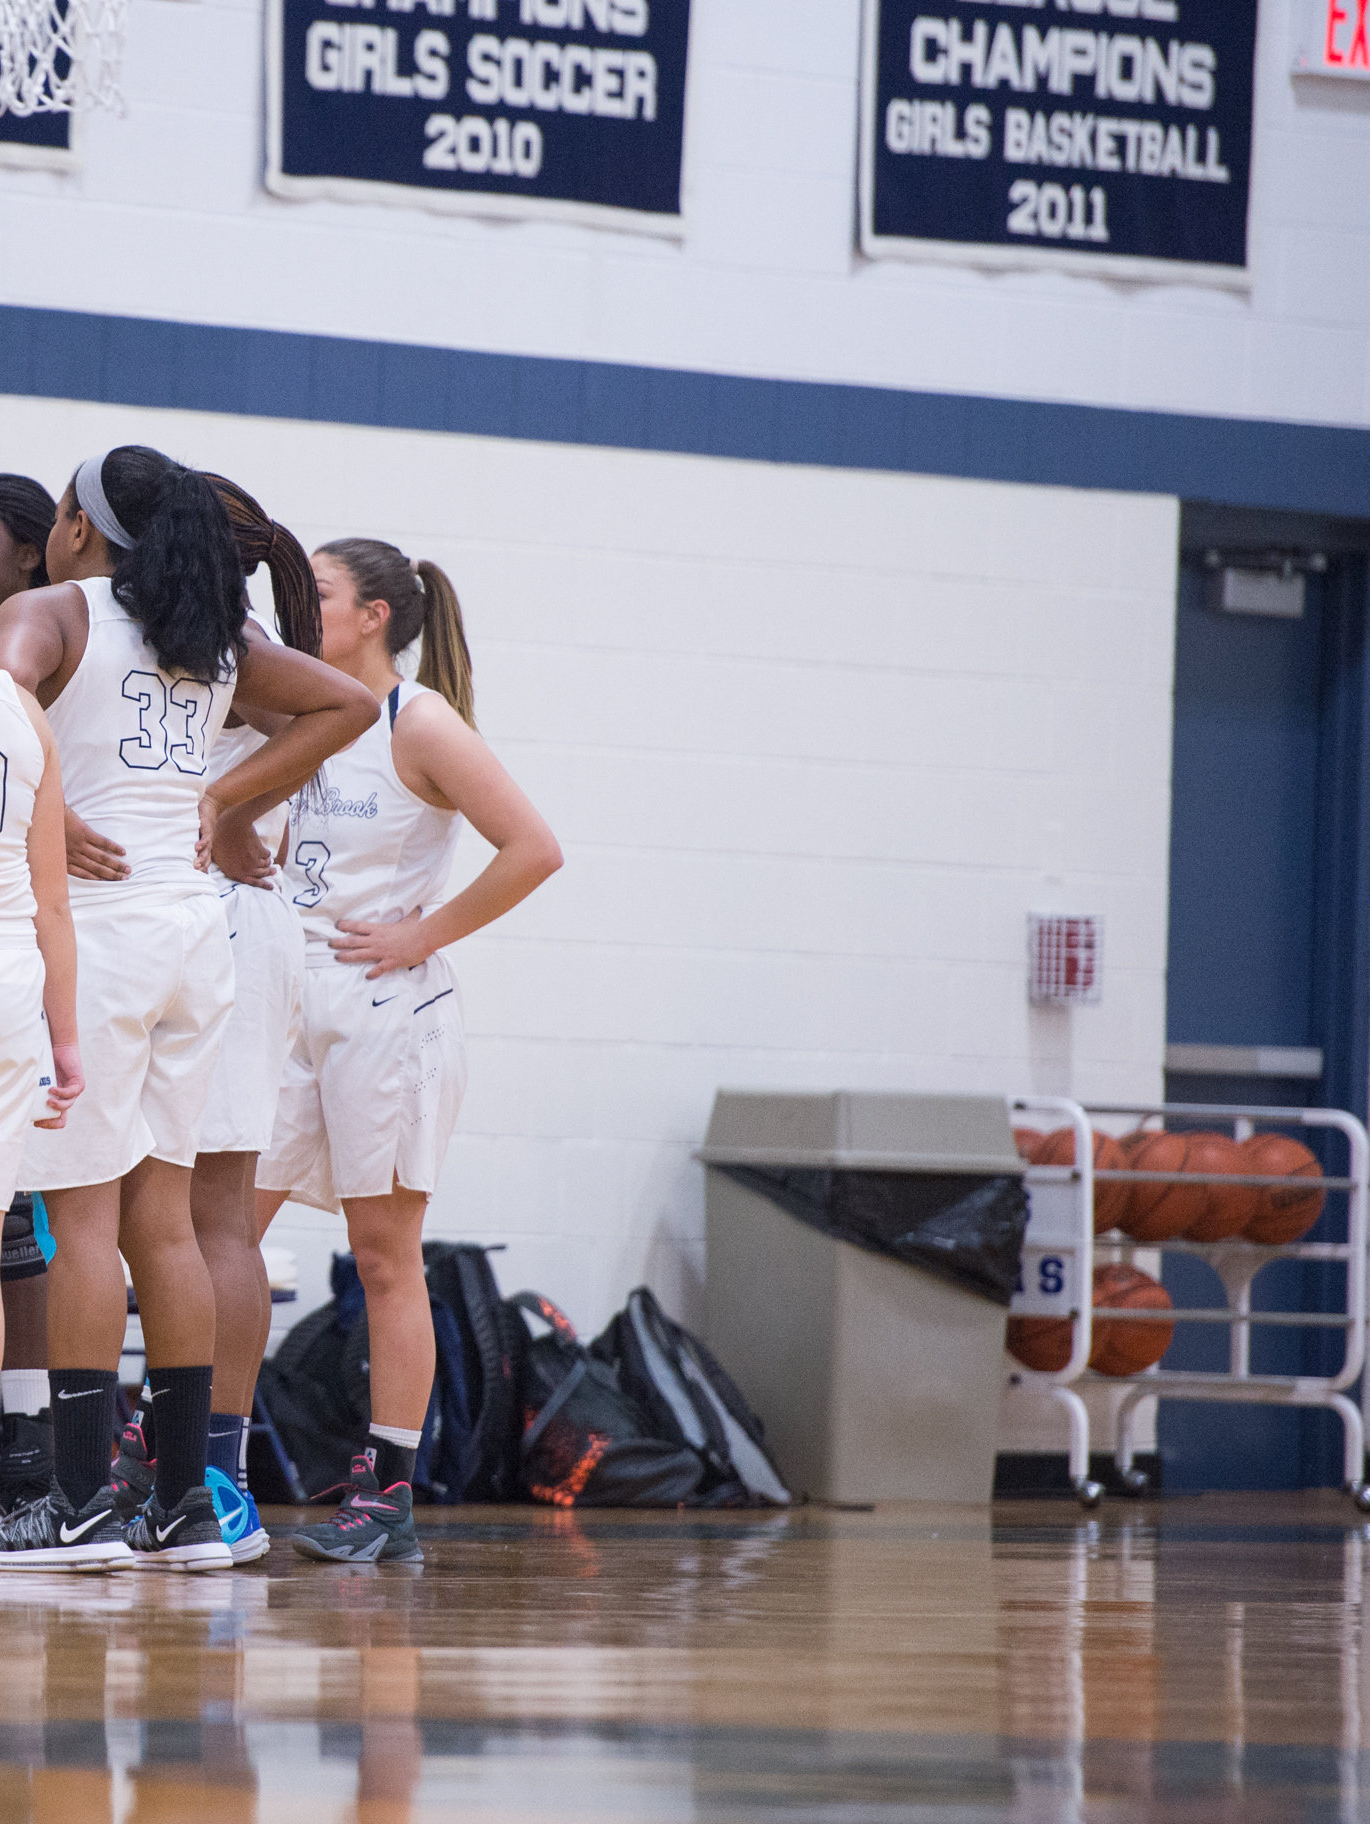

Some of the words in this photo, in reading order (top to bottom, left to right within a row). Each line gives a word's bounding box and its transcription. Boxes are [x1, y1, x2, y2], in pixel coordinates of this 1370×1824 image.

[305, 20, 450, 100] GIRLS
[465, 34, 657, 122] SOCCER
[909, 15, 1217, 111] CHAMPIONS
[423, 114, 543, 179] 2010
[885, 98, 992, 160] GIRLS
[1003, 106, 1230, 184] BASKETBALL
[1007, 179, 1110, 243] 2011
[119, 670, 214, 776] 33
[313, 787, 378, 819] Brook
[293, 841, 331, 908] 3
